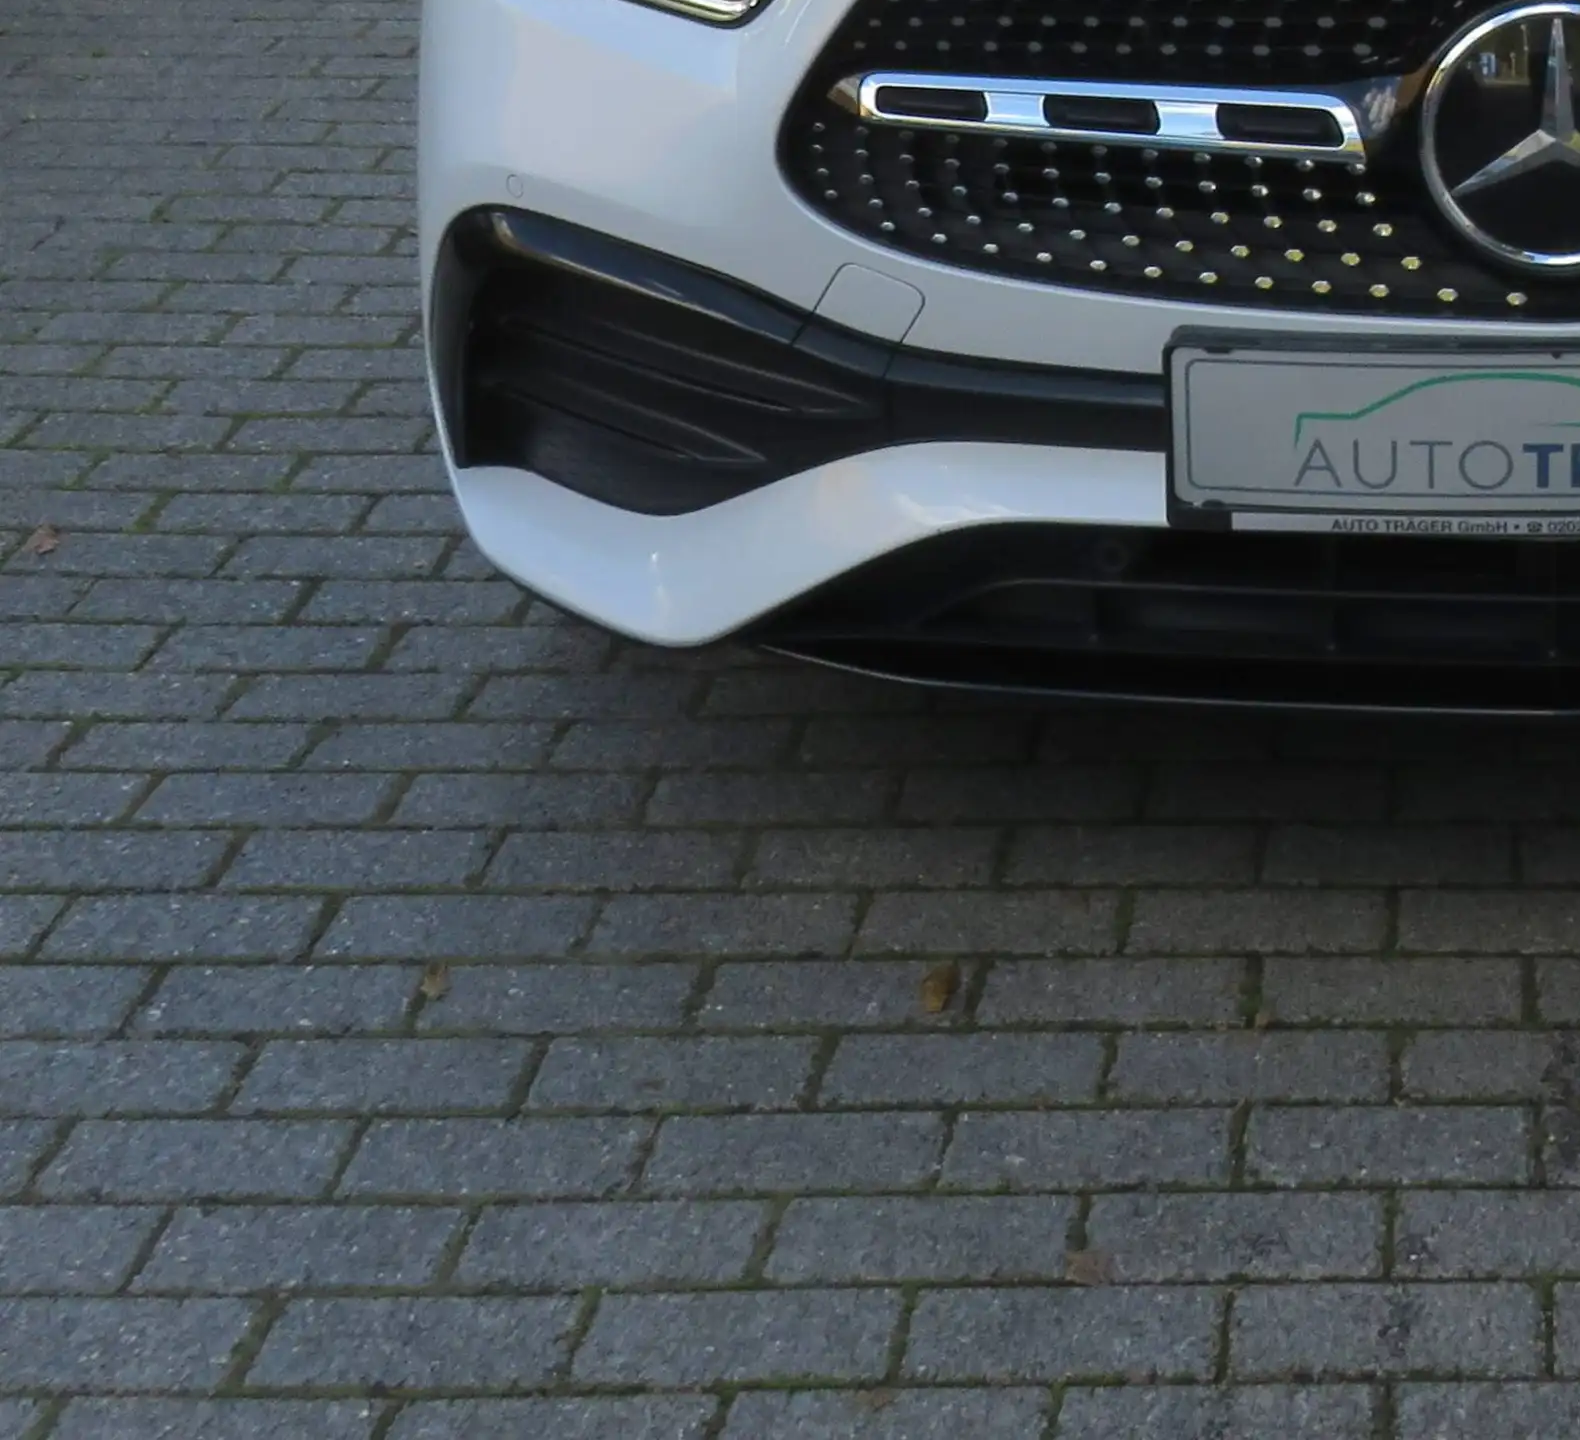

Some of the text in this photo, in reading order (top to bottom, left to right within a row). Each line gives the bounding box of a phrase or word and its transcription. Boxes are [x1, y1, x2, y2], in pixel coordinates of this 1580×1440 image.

[1331, 518, 1379, 532] AUTO
[1383, 517, 1453, 533] TRÄGER
[1457, 520, 1508, 534] GmbH
